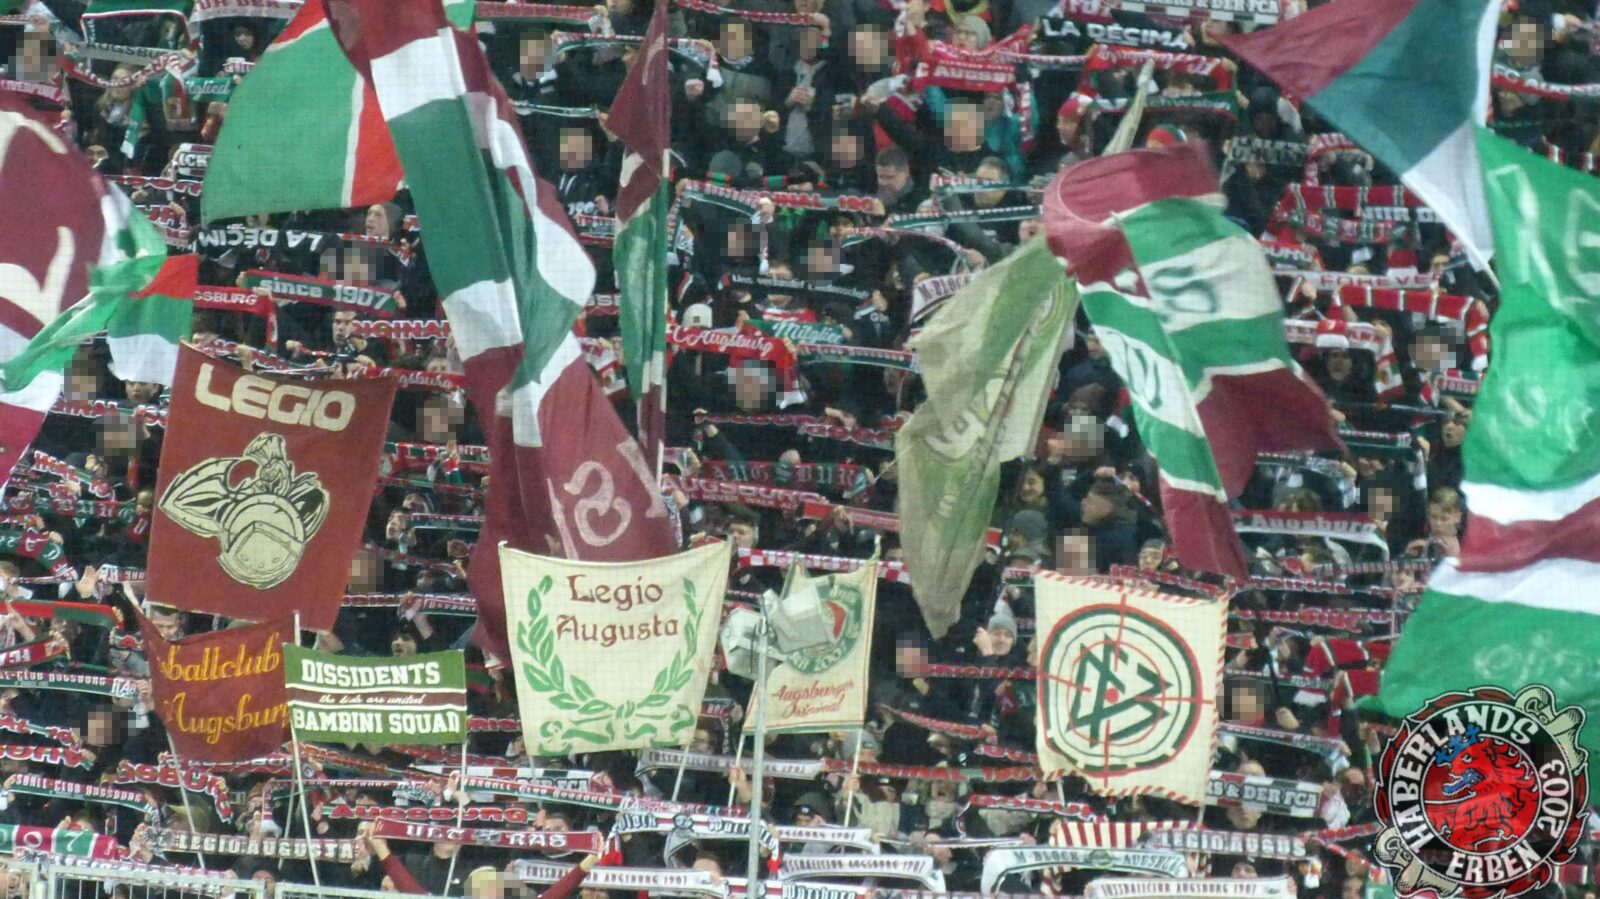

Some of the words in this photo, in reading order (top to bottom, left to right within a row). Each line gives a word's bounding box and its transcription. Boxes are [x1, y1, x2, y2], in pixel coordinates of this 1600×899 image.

[1041, 18, 1081, 38] LA
[194, 290, 259, 306] GSBURG
[258, 277, 322, 299] since
[332, 283, 393, 311] 1907
[195, 362, 356, 432] LEGIO
[566, 573, 664, 611] Legio
[556, 613, 678, 648] Augusta
[161, 631, 281, 682] ballclub
[301, 658, 441, 687] DISSIDENTS
[293, 708, 384, 734] BAMBINI
[388, 710, 461, 735] SQUAD
[1226, 783, 1240, 799] &
[1243, 784, 1282, 804] DER
[1283, 789, 1318, 808] FCA
[1161, 831, 1225, 852] LEGIO
[1230, 835, 1307, 858] AUGUS
[603, 872, 658, 885] AUGSBURG
[663, 874, 688, 886] 1907
[1176, 883, 1229, 895] AUGSBURG
[1233, 883, 1257, 895] 1907
